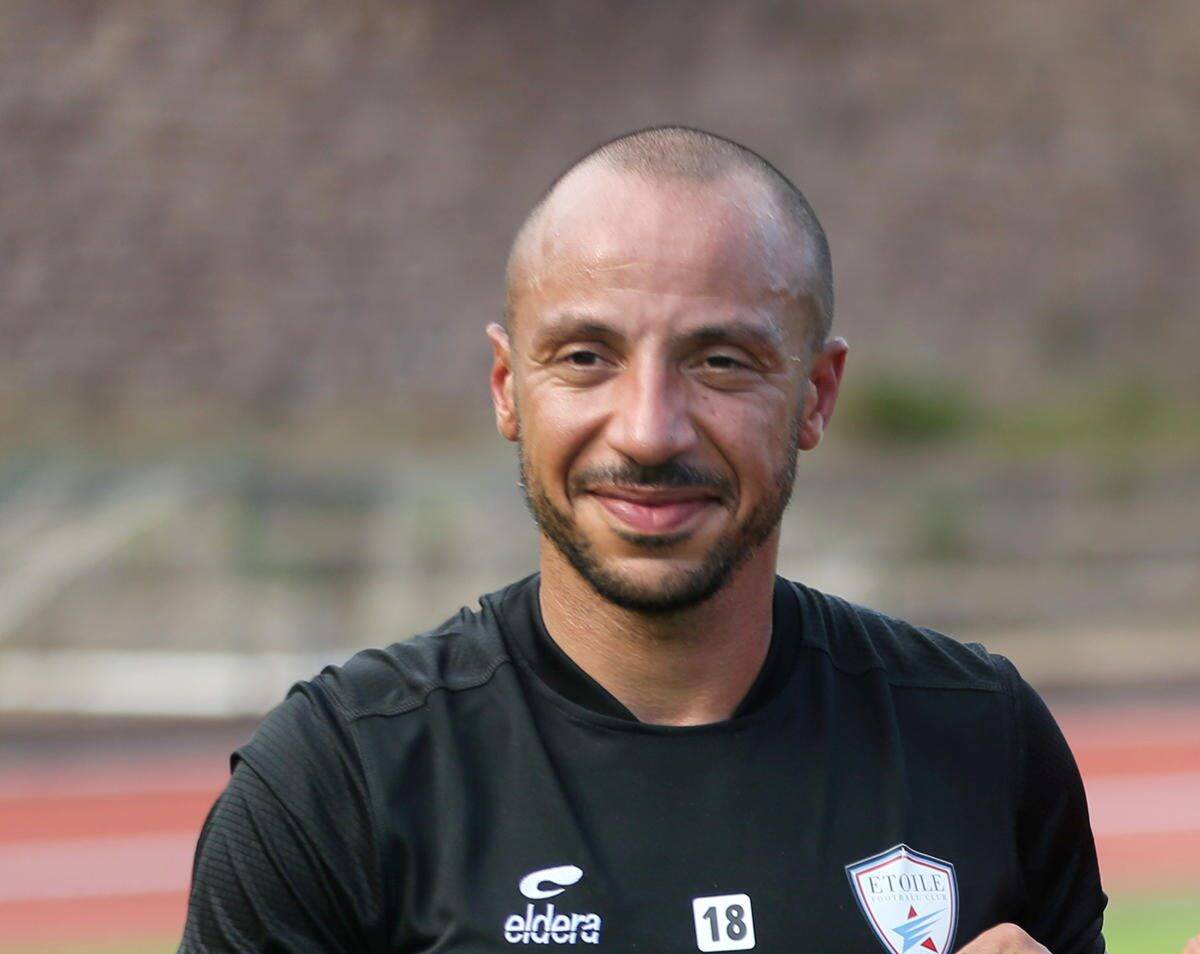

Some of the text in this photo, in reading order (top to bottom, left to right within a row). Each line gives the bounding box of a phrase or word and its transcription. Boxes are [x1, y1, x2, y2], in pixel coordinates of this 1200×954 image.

[867, 873, 945, 894] ETOILE
[504, 903, 601, 944] eldera
[702, 904, 747, 942] 18
